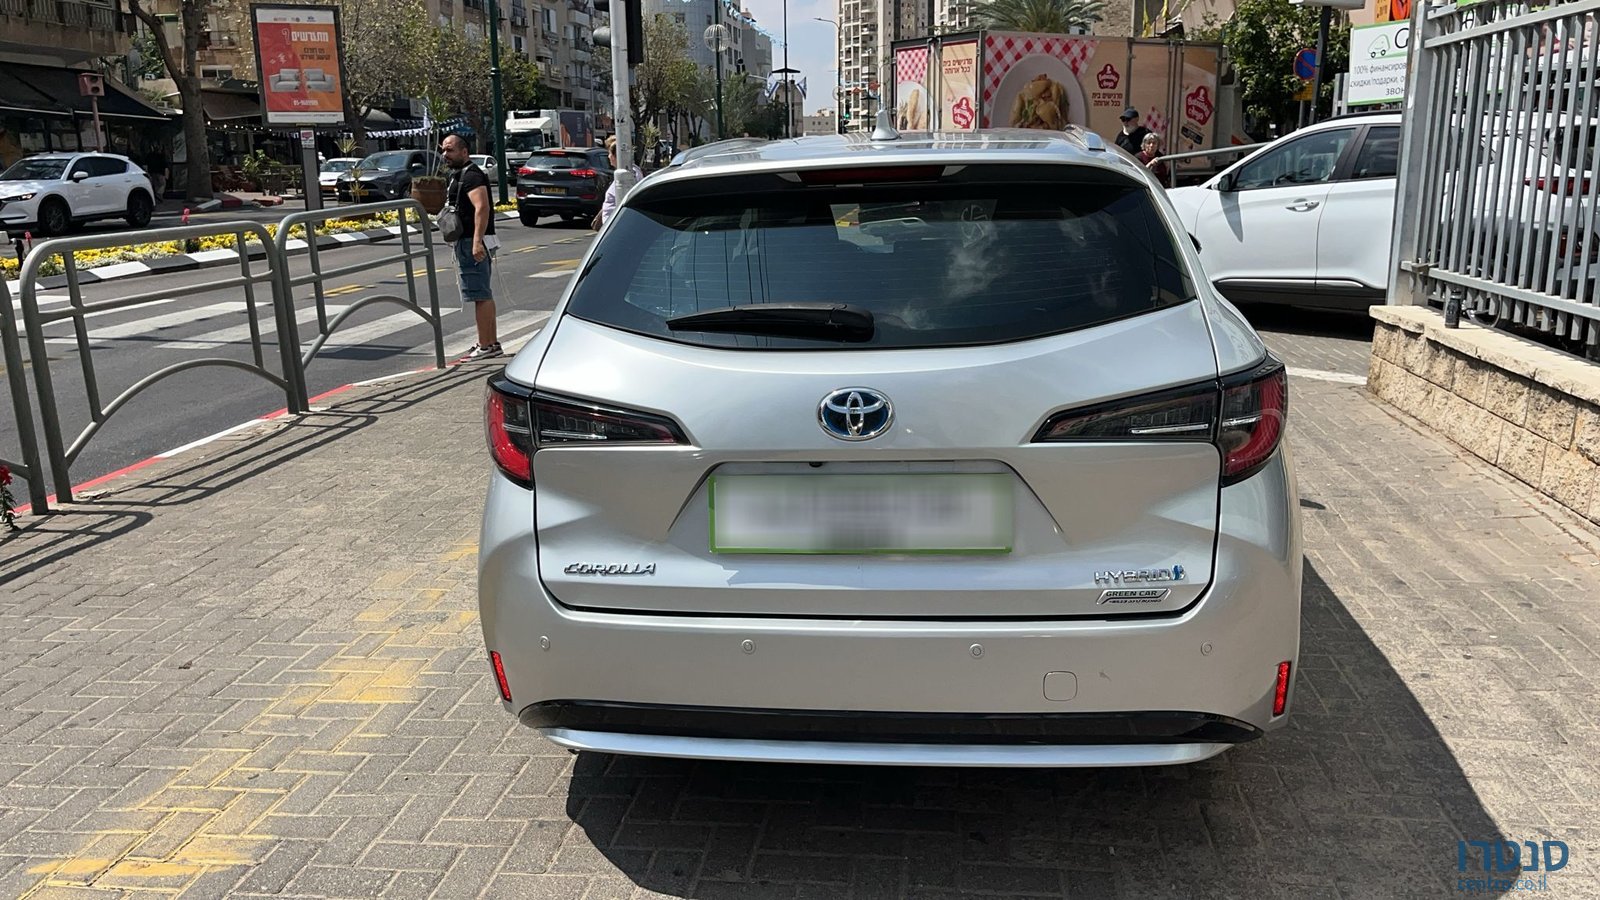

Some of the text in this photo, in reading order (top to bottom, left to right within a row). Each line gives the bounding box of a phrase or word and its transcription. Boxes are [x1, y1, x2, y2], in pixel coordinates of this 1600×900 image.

[1353, 64, 1370, 75] 100%
[563, 562, 657, 576] COROLLA
[1094, 568, 1172, 584] HYBRID
[1105, 590, 1137, 598] GREEN
